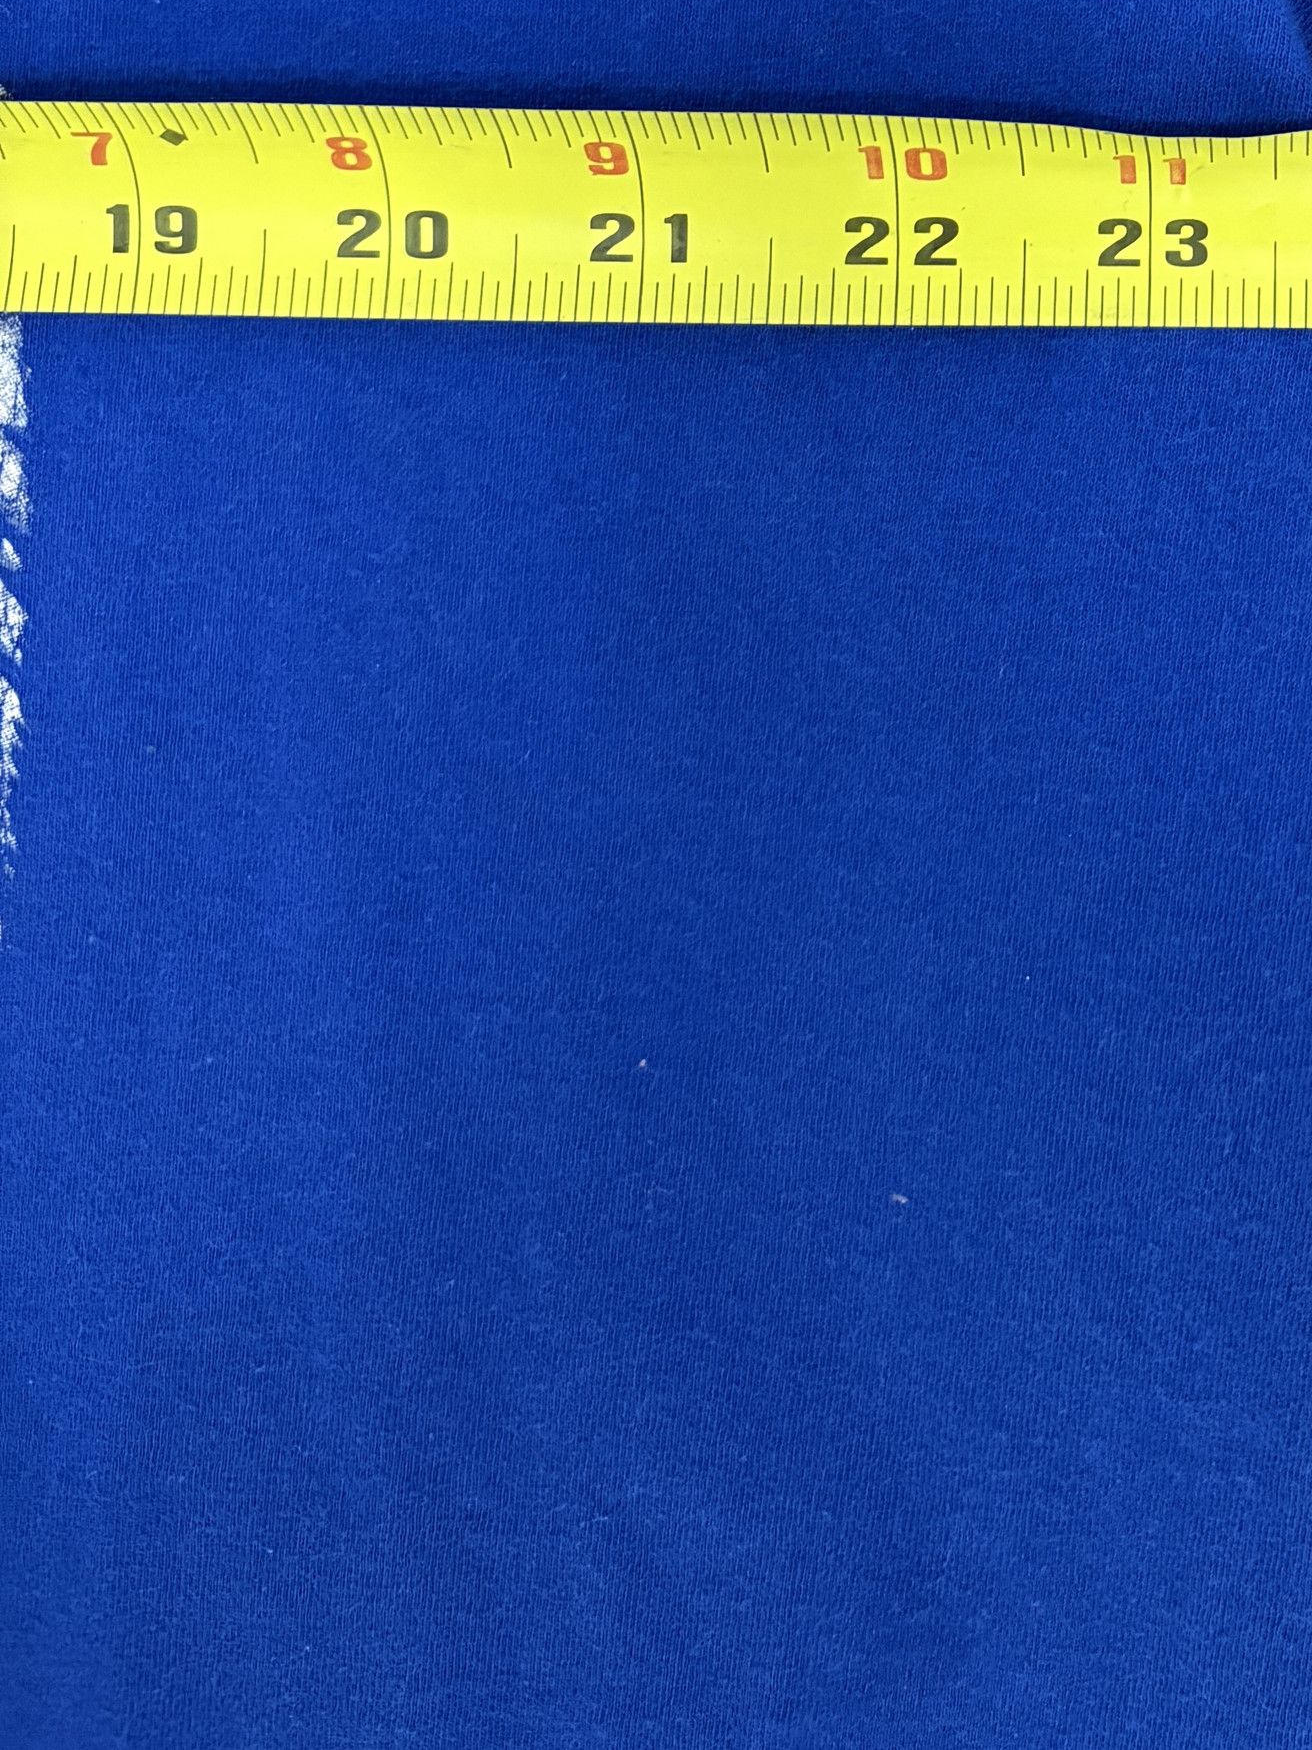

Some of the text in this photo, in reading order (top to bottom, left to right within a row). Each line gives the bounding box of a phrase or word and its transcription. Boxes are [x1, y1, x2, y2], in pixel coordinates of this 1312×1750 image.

[71, 132, 112, 166] 7
[326, 137, 373, 170] 8
[584, 142, 629, 175] 9
[858, 146, 948, 180] 10
[1113, 155, 1186, 184] 11
[106, 204, 198, 254] 19
[337, 208, 449, 259] 20
[589, 213, 689, 263] 21
[845, 216, 960, 265] 22
[1098, 218, 1209, 267] 23
